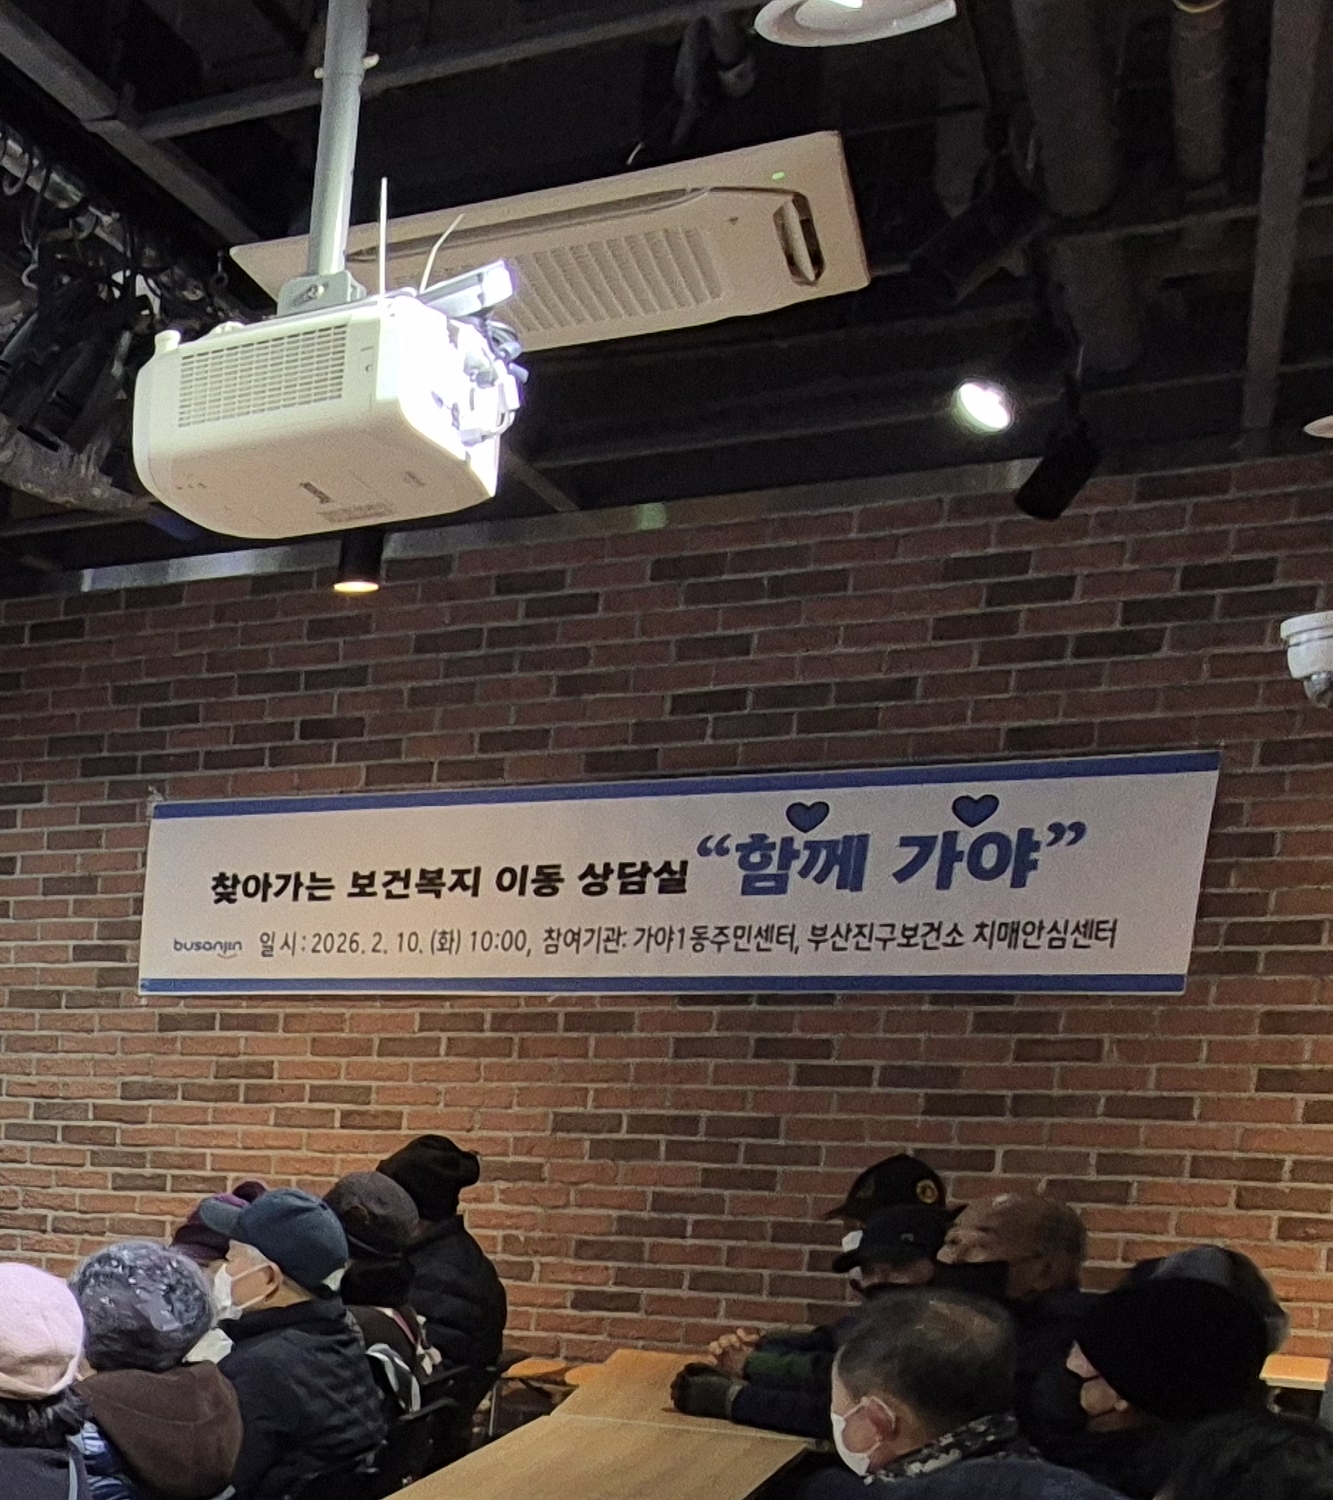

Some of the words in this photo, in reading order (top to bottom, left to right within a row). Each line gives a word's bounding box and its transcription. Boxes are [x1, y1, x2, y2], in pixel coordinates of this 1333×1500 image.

[211, 871, 336, 904] 찾아가는
[347, 866, 482, 899] 보건복지
[495, 863, 565, 897] 이동
[578, 859, 689, 895] 상담실
[173, 938, 243, 954] busanjin
[543, 925, 628, 955] 참여기관:
[807, 920, 965, 952] 부산진구보건소
[973, 917, 1118, 950] 치매안심센터
